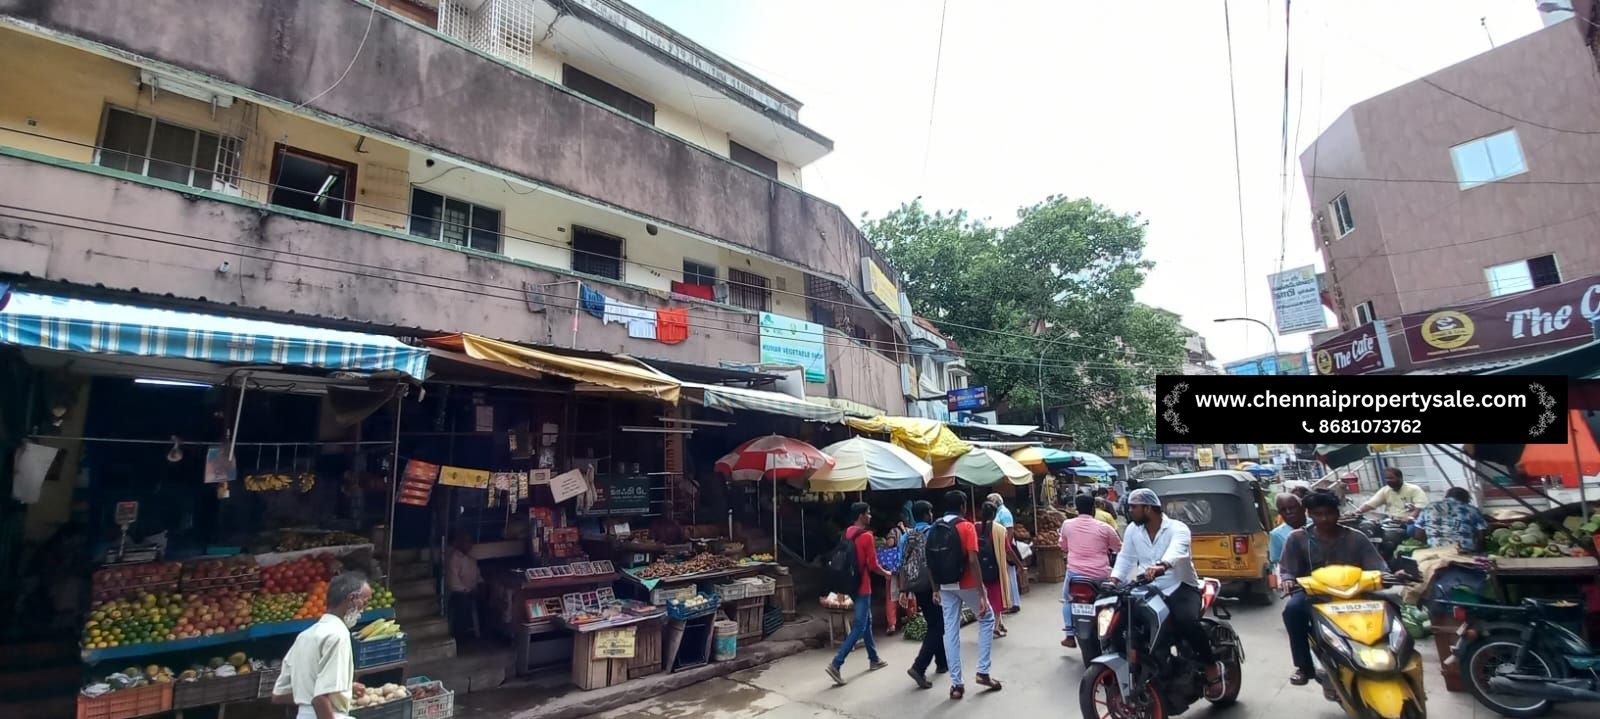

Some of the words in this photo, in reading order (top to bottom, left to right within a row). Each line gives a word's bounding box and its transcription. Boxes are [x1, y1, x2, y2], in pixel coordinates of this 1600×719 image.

[1505, 305, 1573, 340] The
[1333, 351, 1351, 369] The
[1351, 333, 1374, 360] Cafe
